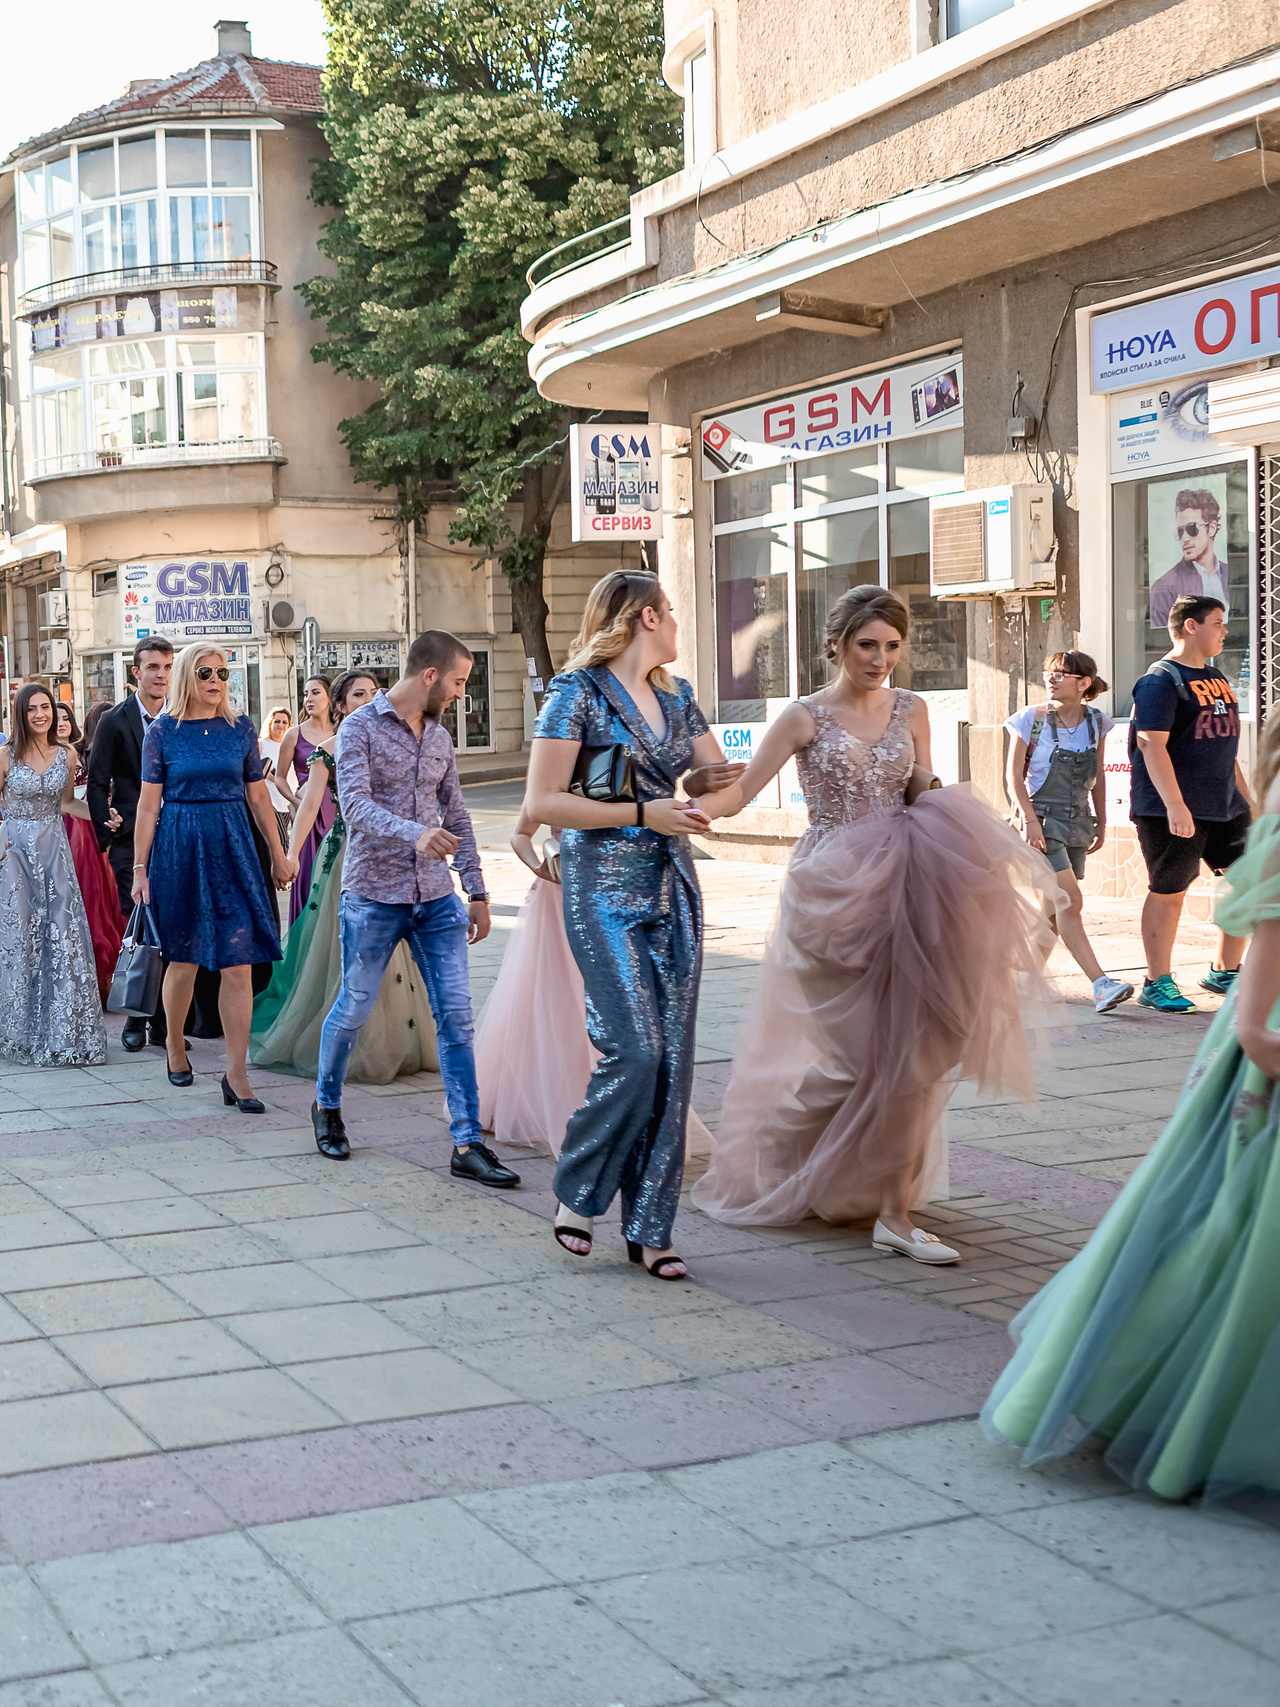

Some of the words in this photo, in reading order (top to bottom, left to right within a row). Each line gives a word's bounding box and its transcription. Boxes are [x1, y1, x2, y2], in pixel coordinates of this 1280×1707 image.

[1106, 329, 1177, 365] HOYA
[1100, 367, 1128, 379] ЯПОНСКИ
[1129, 361, 1153, 372] СТЪКЛА
[1154, 359, 1162, 367] ЗА
[1163, 353, 1186, 364] ОЧИЛА
[764, 378, 891, 443] GSM
[1140, 399, 1152, 409] BLUE
[591, 434, 651, 458] GSM
[781, 421, 891, 459] АГАЗИН
[1127, 451, 1150, 461] HOYA
[583, 481, 658, 494] МАГАЗИН
[592, 516, 652, 530] СЕРВИЗ
[157, 562, 250, 597] GSM
[156, 598, 251, 623] МАГАЗИН
[1189, 678, 1238, 706] RUN
[723, 729, 751, 747] GSM
[723, 749, 752, 760] СЕРВИЗ
